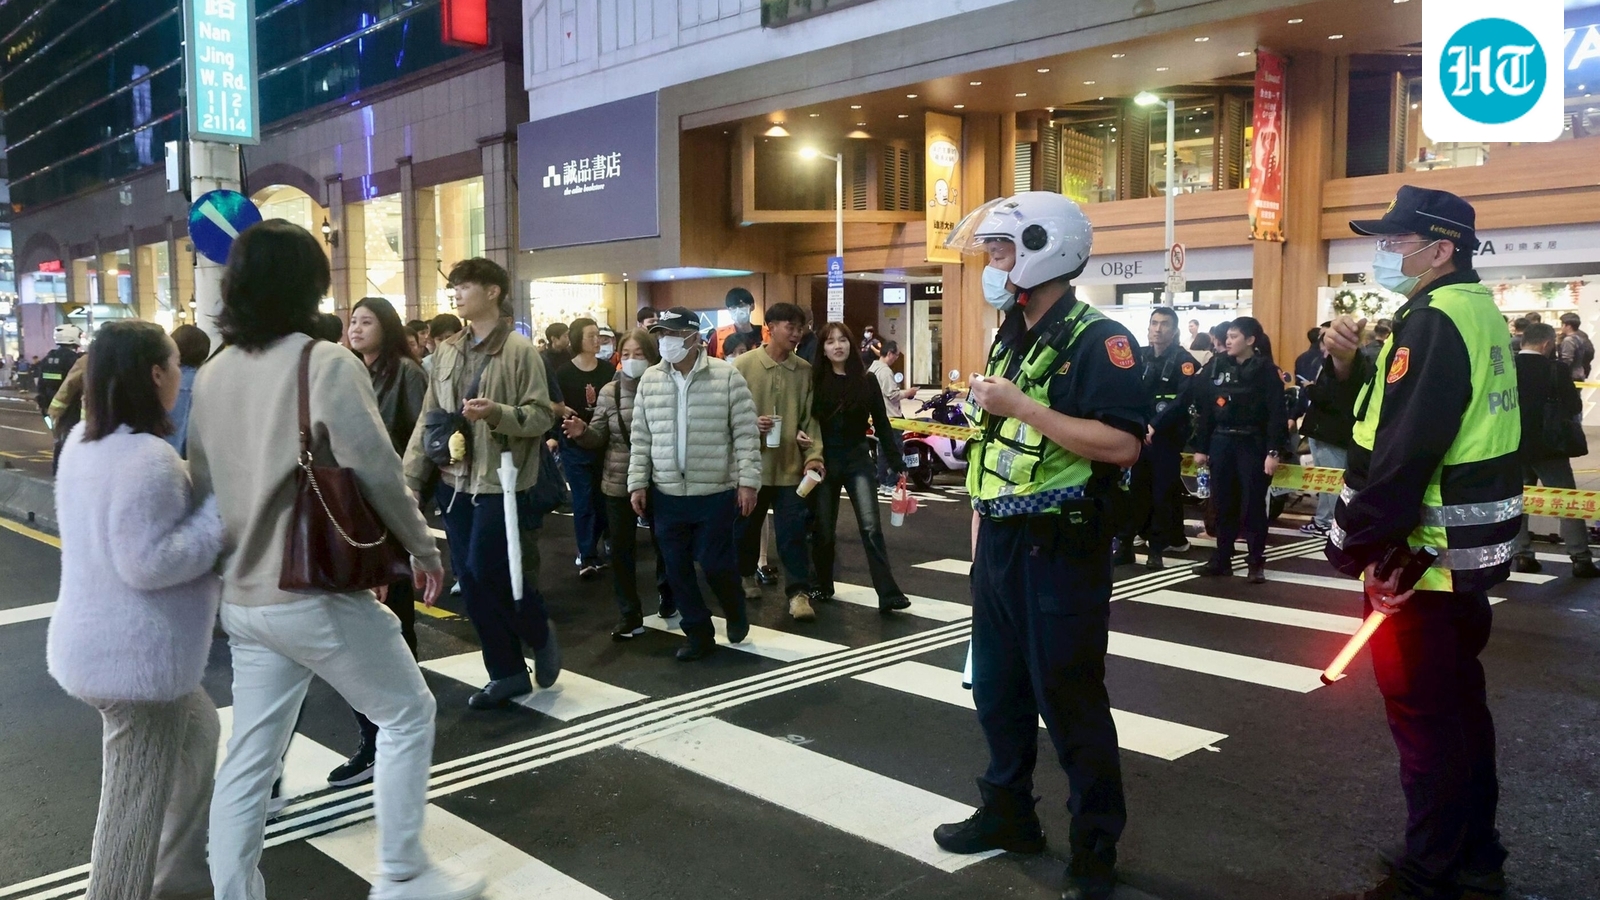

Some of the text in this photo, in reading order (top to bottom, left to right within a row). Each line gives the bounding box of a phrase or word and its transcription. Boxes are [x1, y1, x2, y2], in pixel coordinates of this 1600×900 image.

[199, 21, 231, 43] Nan
[200, 45, 235, 71] Jing
[200, 68, 247, 91] W. Rd.
[563, 152, 621, 185] 誠品書店
[1101, 260, 1143, 279] OBgE
[925, 286, 936, 294] LE
